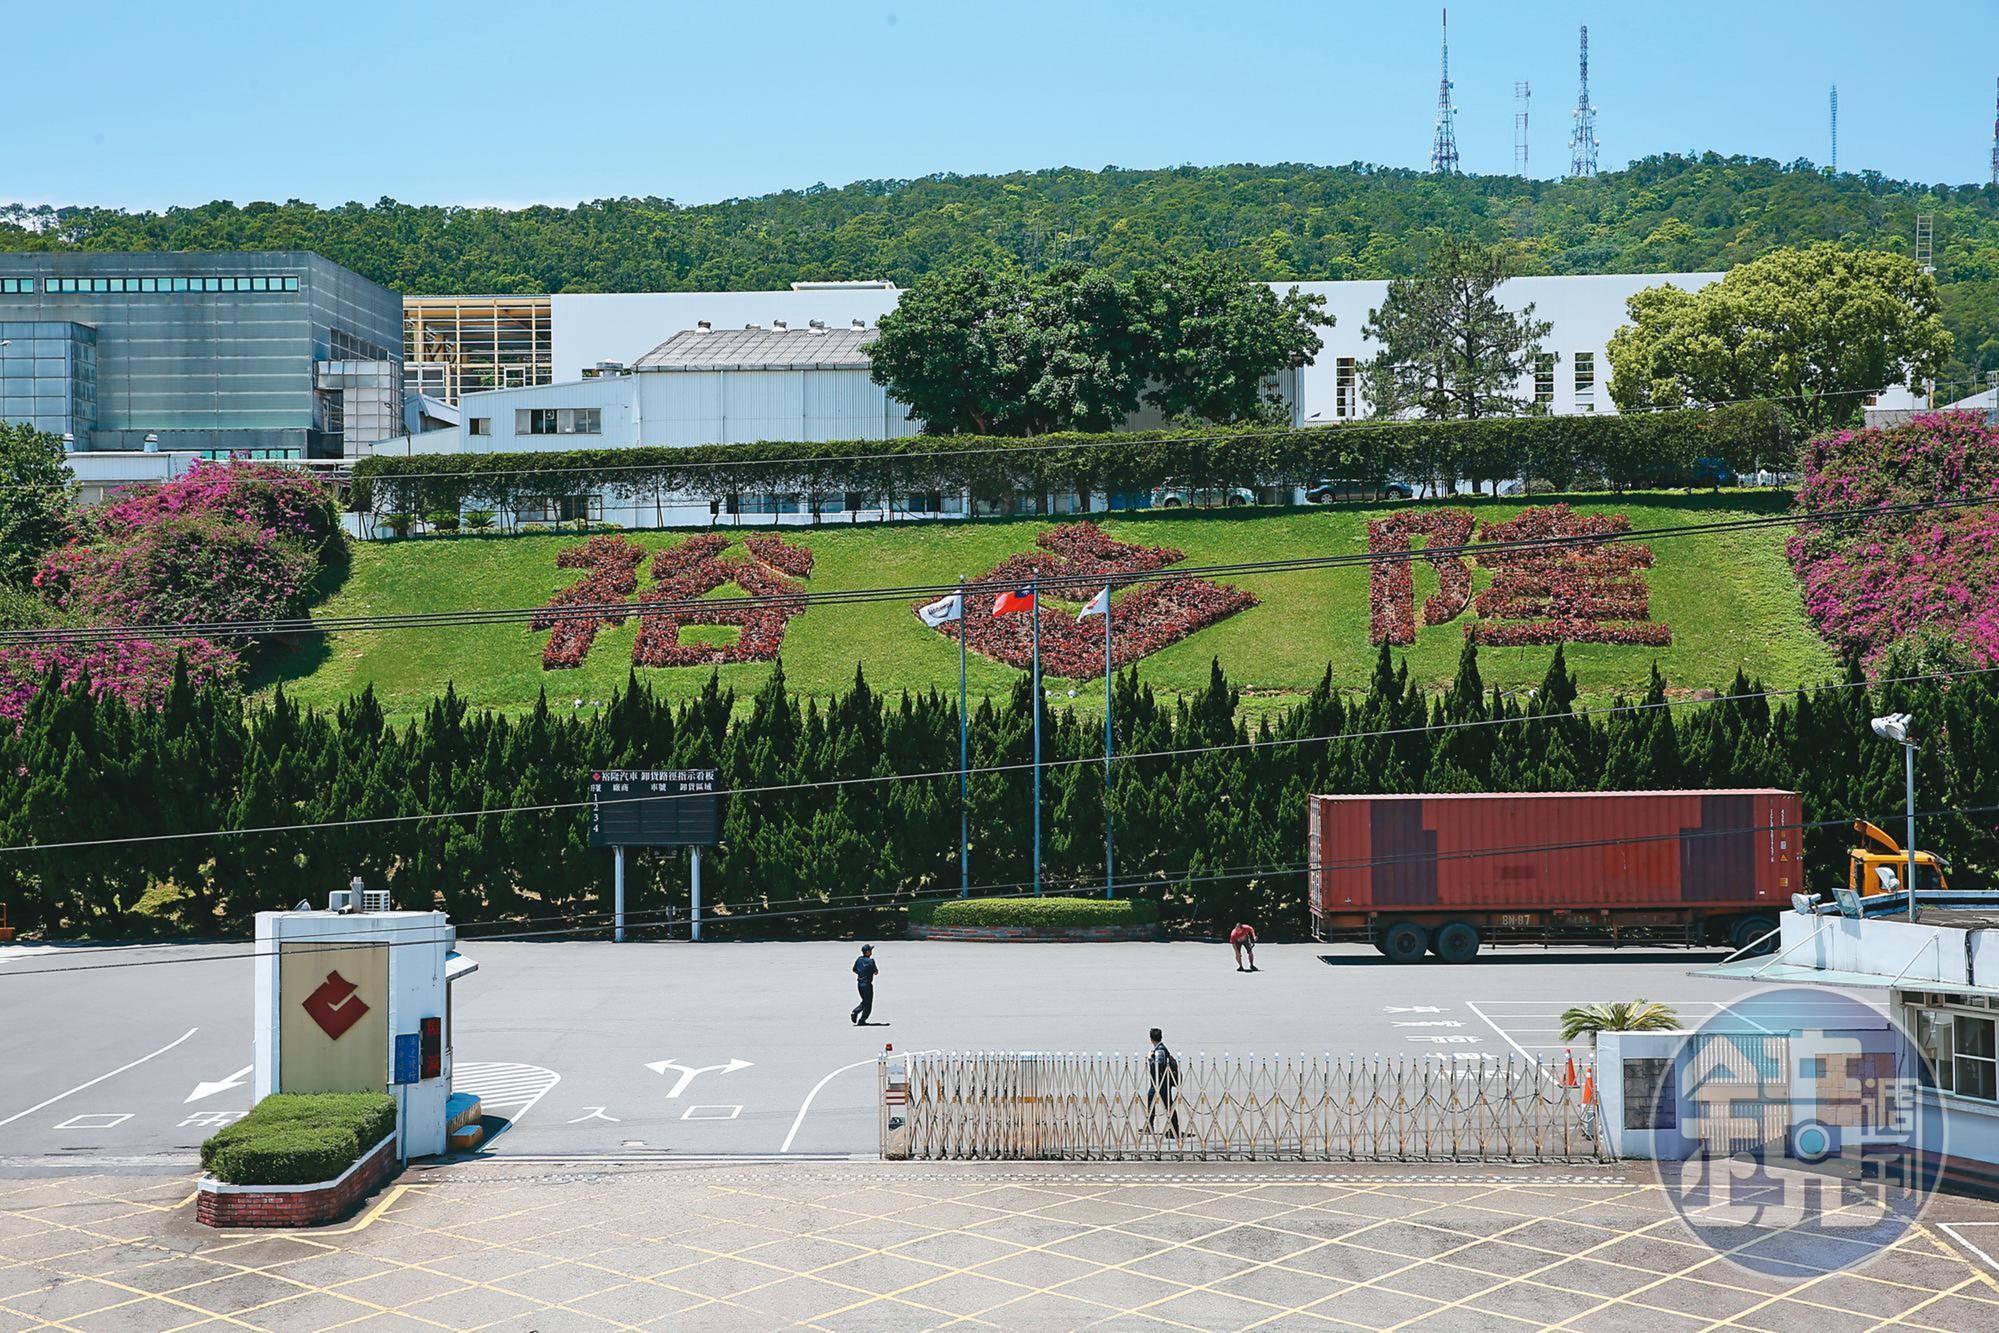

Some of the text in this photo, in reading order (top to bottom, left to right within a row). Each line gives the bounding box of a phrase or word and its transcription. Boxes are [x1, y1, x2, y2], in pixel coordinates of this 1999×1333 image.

[1369, 502, 1672, 646] 隆
[602, 771, 714, 781] 裕隆汽車 卸貨路徑指示看板
[593, 804, 599, 812] 2
[593, 814, 599, 822] 3
[593, 824, 599, 833] 4
[566, 1104, 744, 1124] 入口
